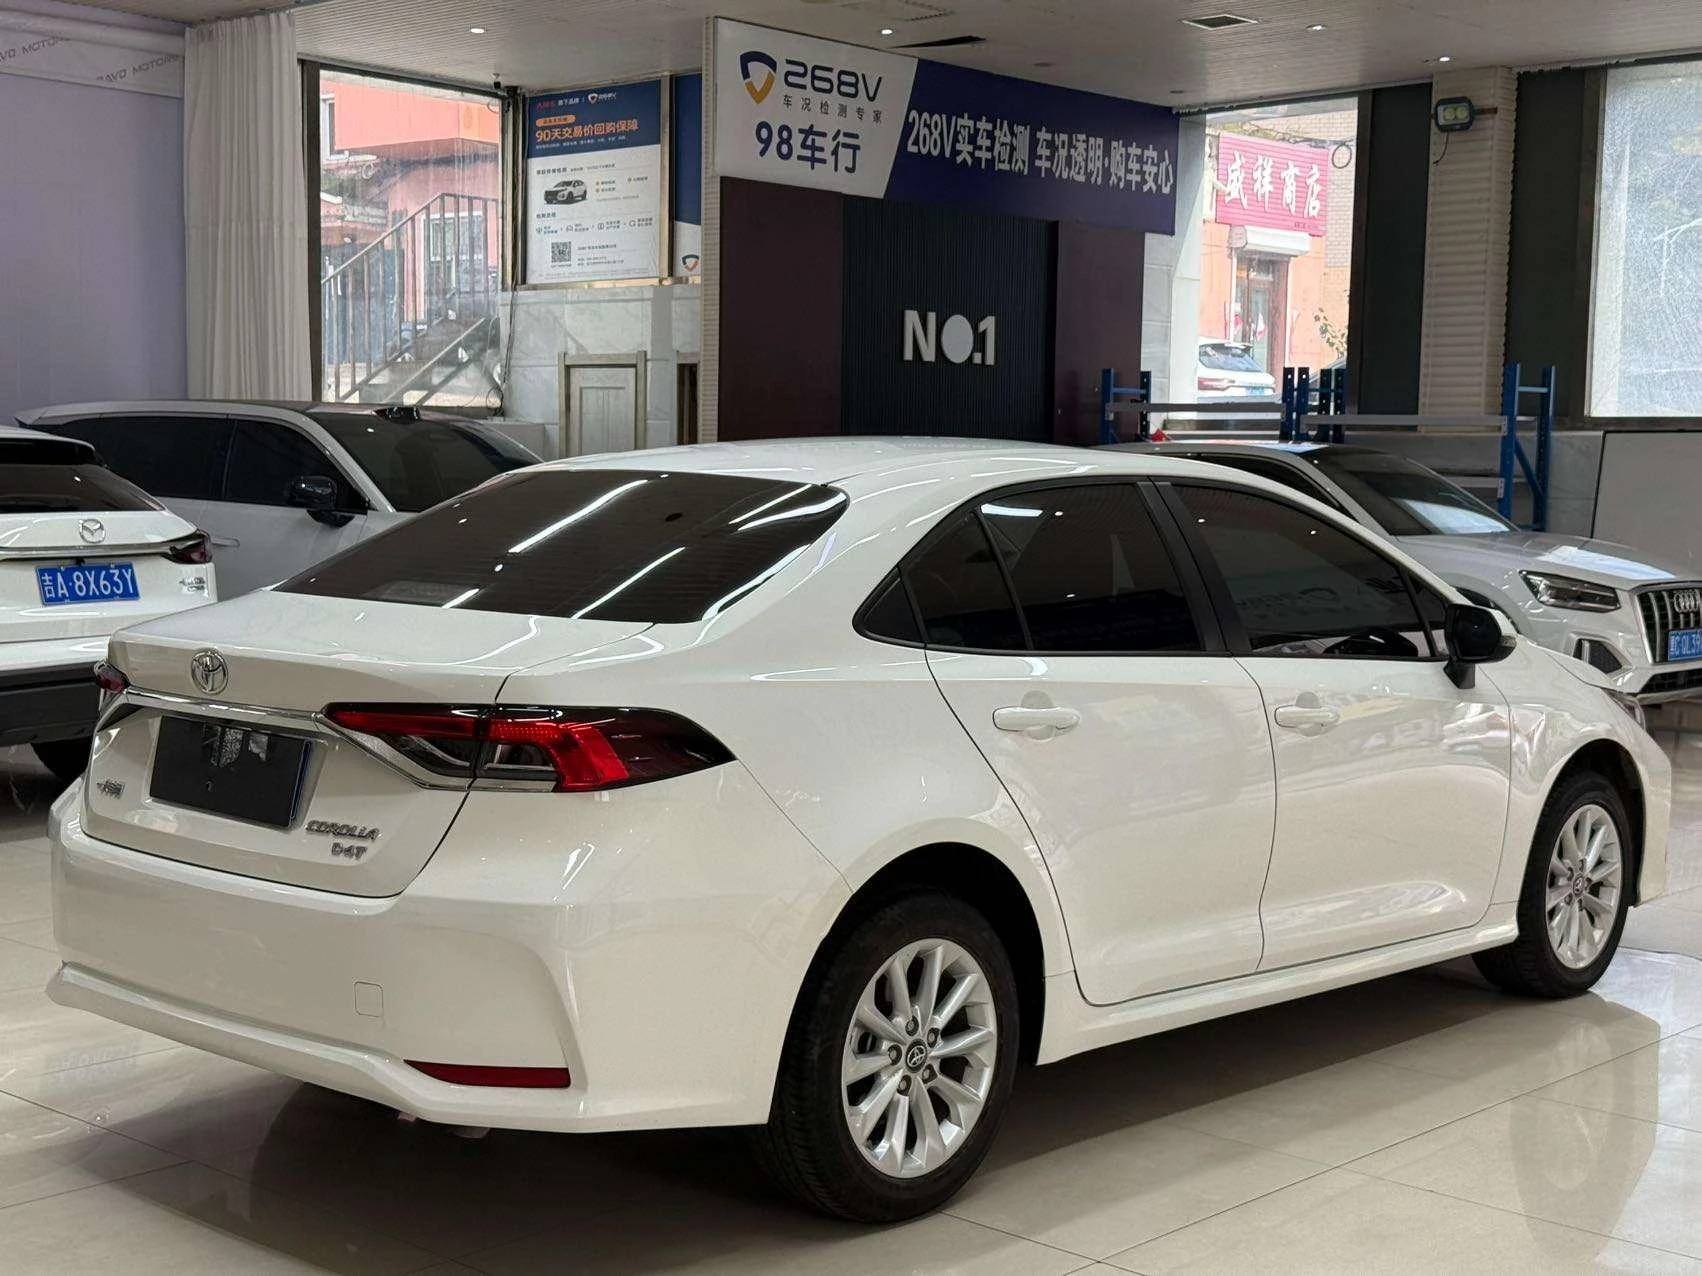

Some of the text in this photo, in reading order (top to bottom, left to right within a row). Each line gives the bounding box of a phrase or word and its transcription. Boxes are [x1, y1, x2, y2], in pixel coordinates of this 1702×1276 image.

[784, 58, 882, 102] 268V
[783, 94, 883, 124] 车况检测专家
[755, 120, 861, 174] 98车行
[906, 109, 1174, 194] 268V实车检测 车况透明·购车安心
[1224, 149, 1322, 219] 盛祥商店
[903, 309, 995, 365] NO.1
[306, 819, 379, 842] COROLLA
